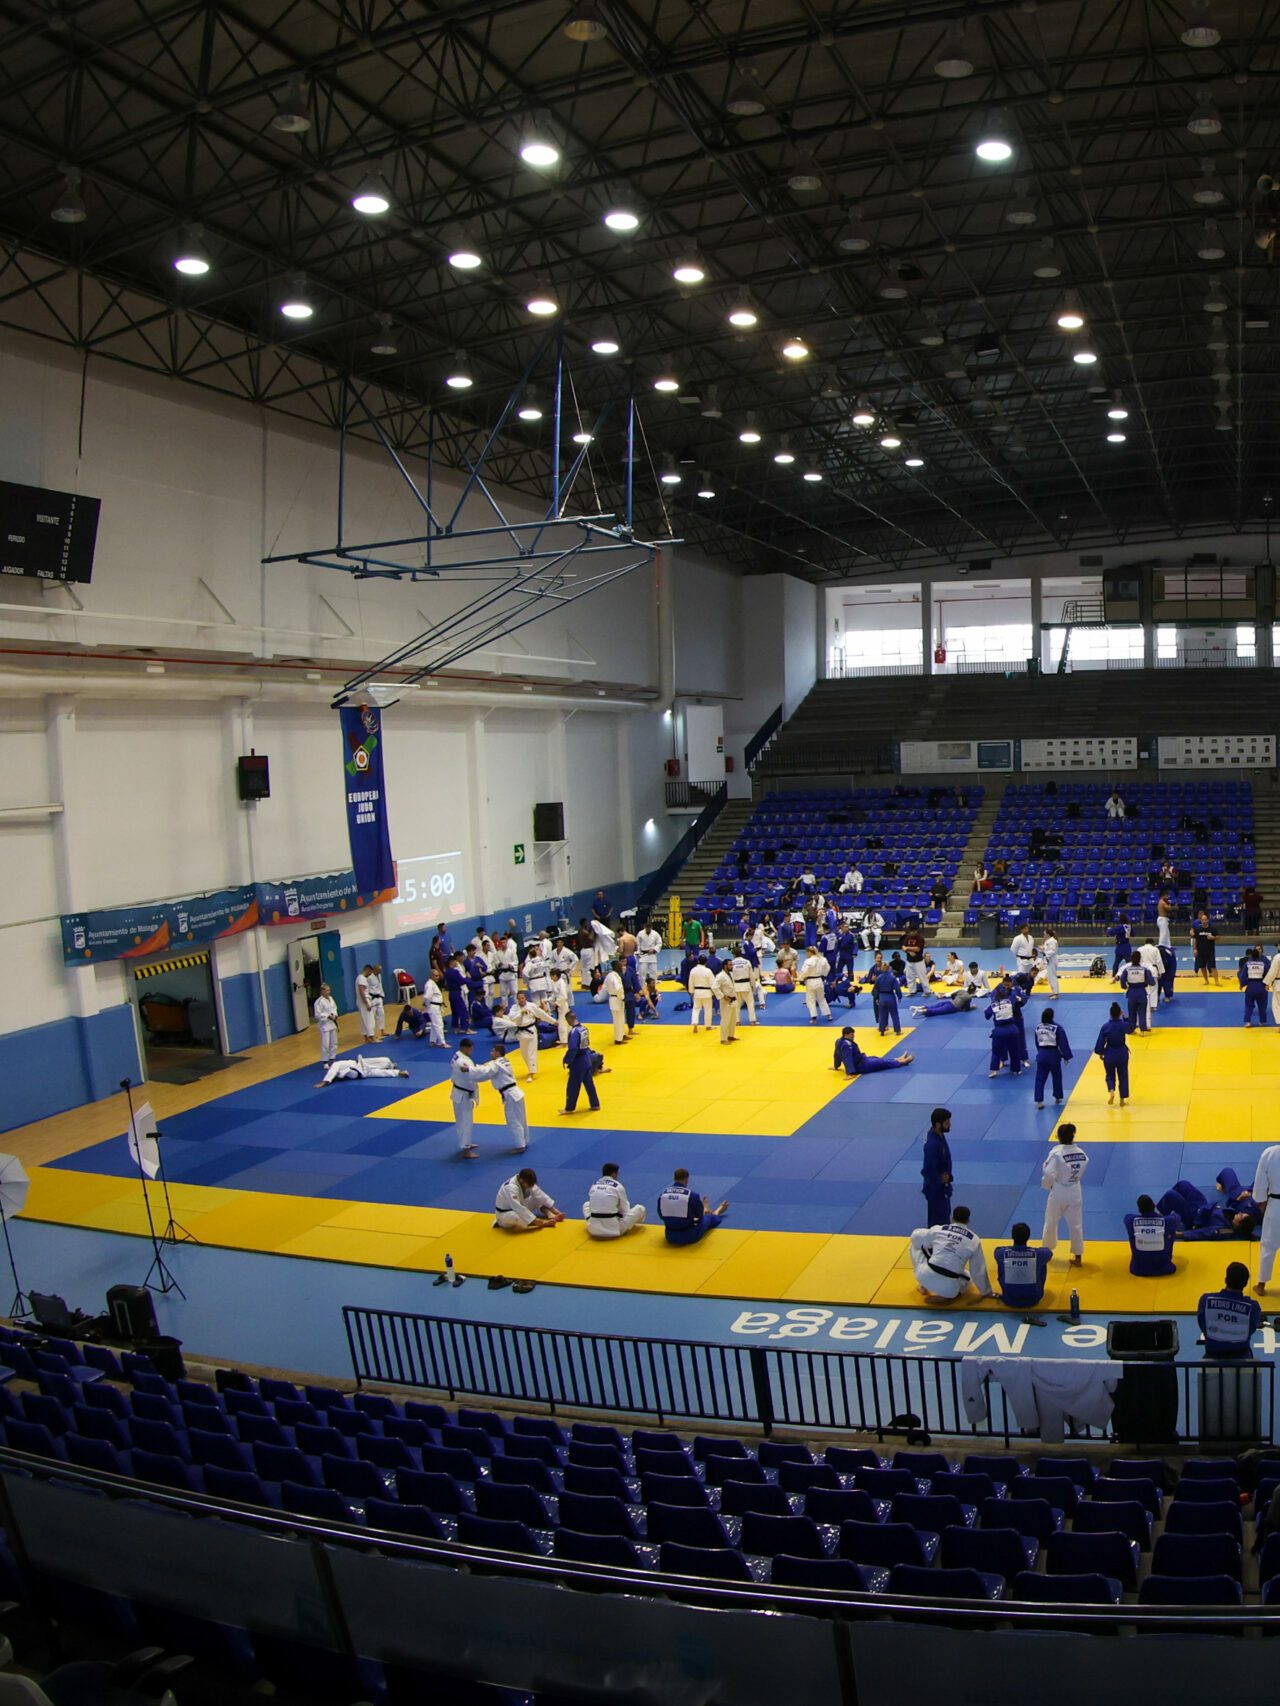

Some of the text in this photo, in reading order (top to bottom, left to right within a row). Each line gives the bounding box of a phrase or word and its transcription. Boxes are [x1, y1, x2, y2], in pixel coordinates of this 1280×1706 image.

[358, 801, 374, 813] JUDO
[356, 811, 376, 824] UNION
[392, 872, 455, 904] 15:00
[300, 889, 344, 904] Ayuntamiento
[88, 928, 129, 940] Ayuntamiento
[947, 1233, 963, 1243] POR
[1210, 1298, 1247, 1313] PEDRO LIMA
[1217, 1312, 1238, 1323] POR
[730, 1308, 1031, 1354] Málaga
